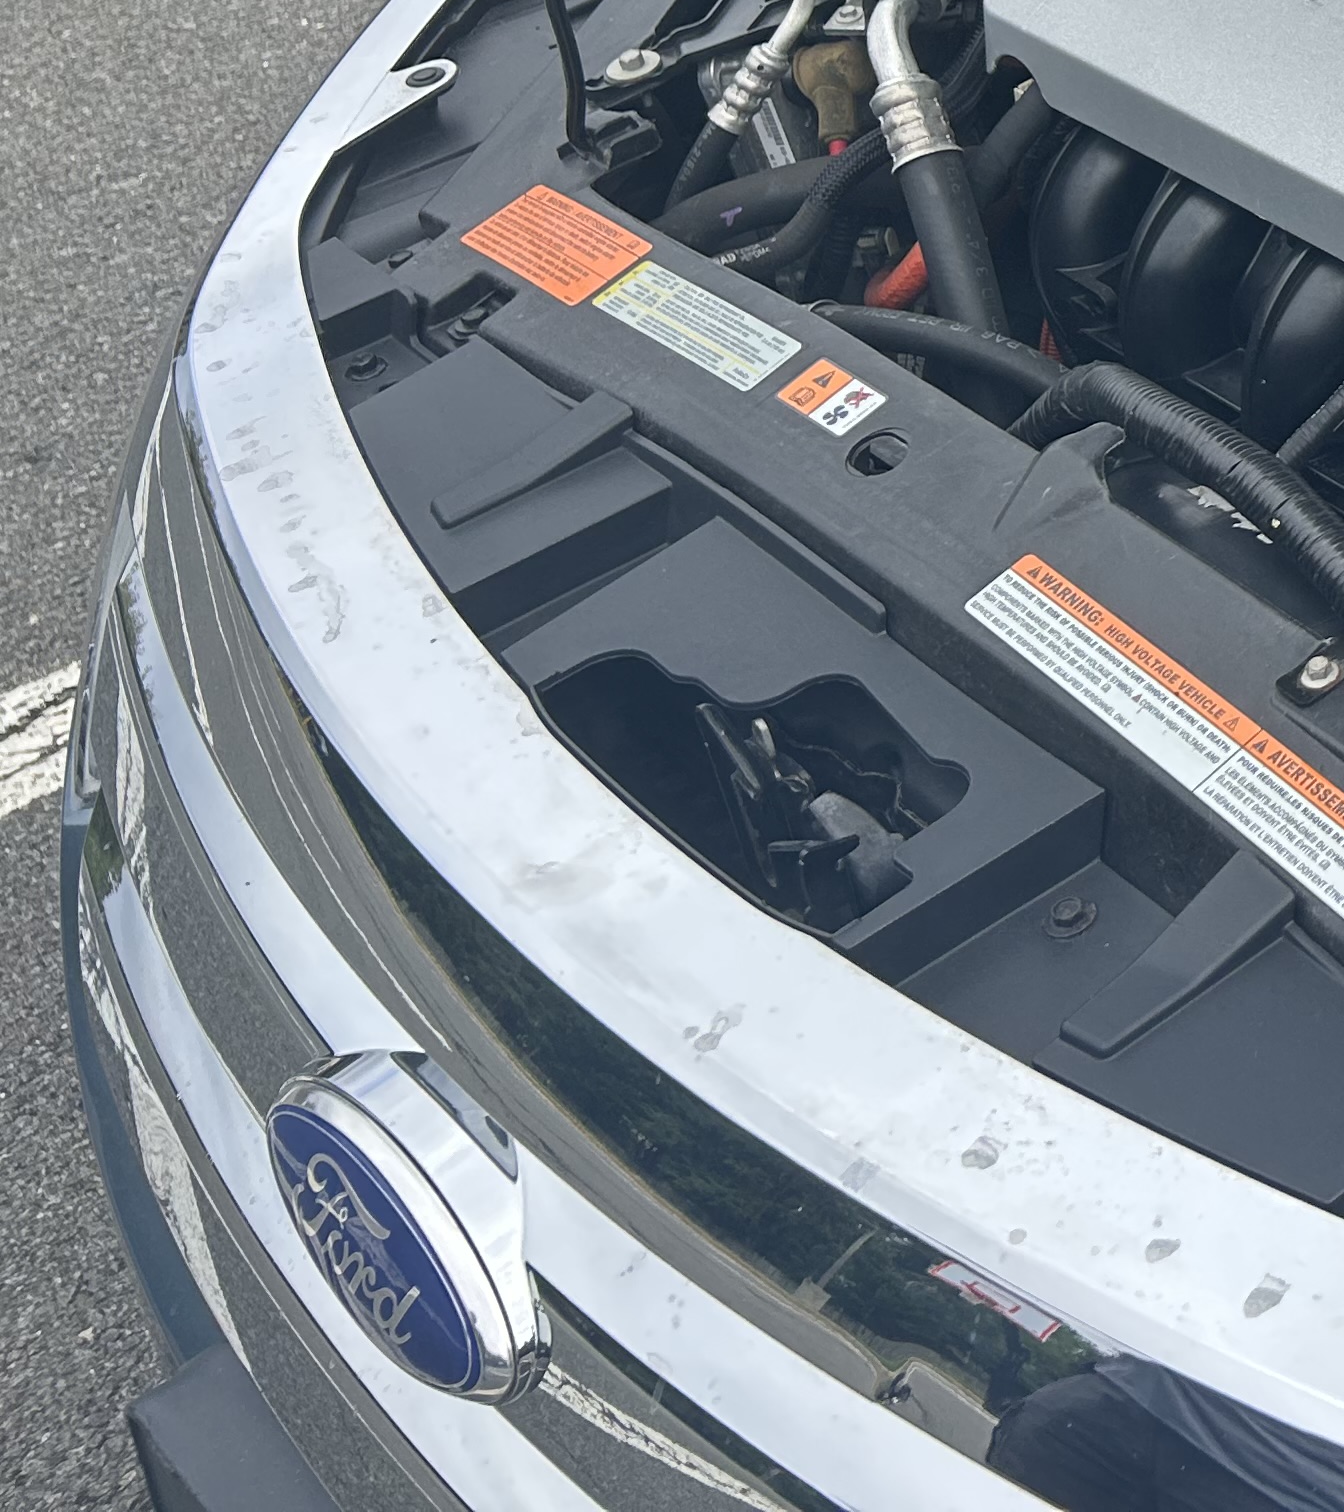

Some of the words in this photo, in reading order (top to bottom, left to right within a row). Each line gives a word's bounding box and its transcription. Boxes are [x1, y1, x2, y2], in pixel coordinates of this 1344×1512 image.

[1037, 571, 1107, 627] WARNING:
[1102, 622, 1135, 649] HIGH
[1129, 643, 1181, 685] VOLTAGE
[1175, 679, 1227, 721] VEHICLE
[290, 1151, 422, 1346] Ford
